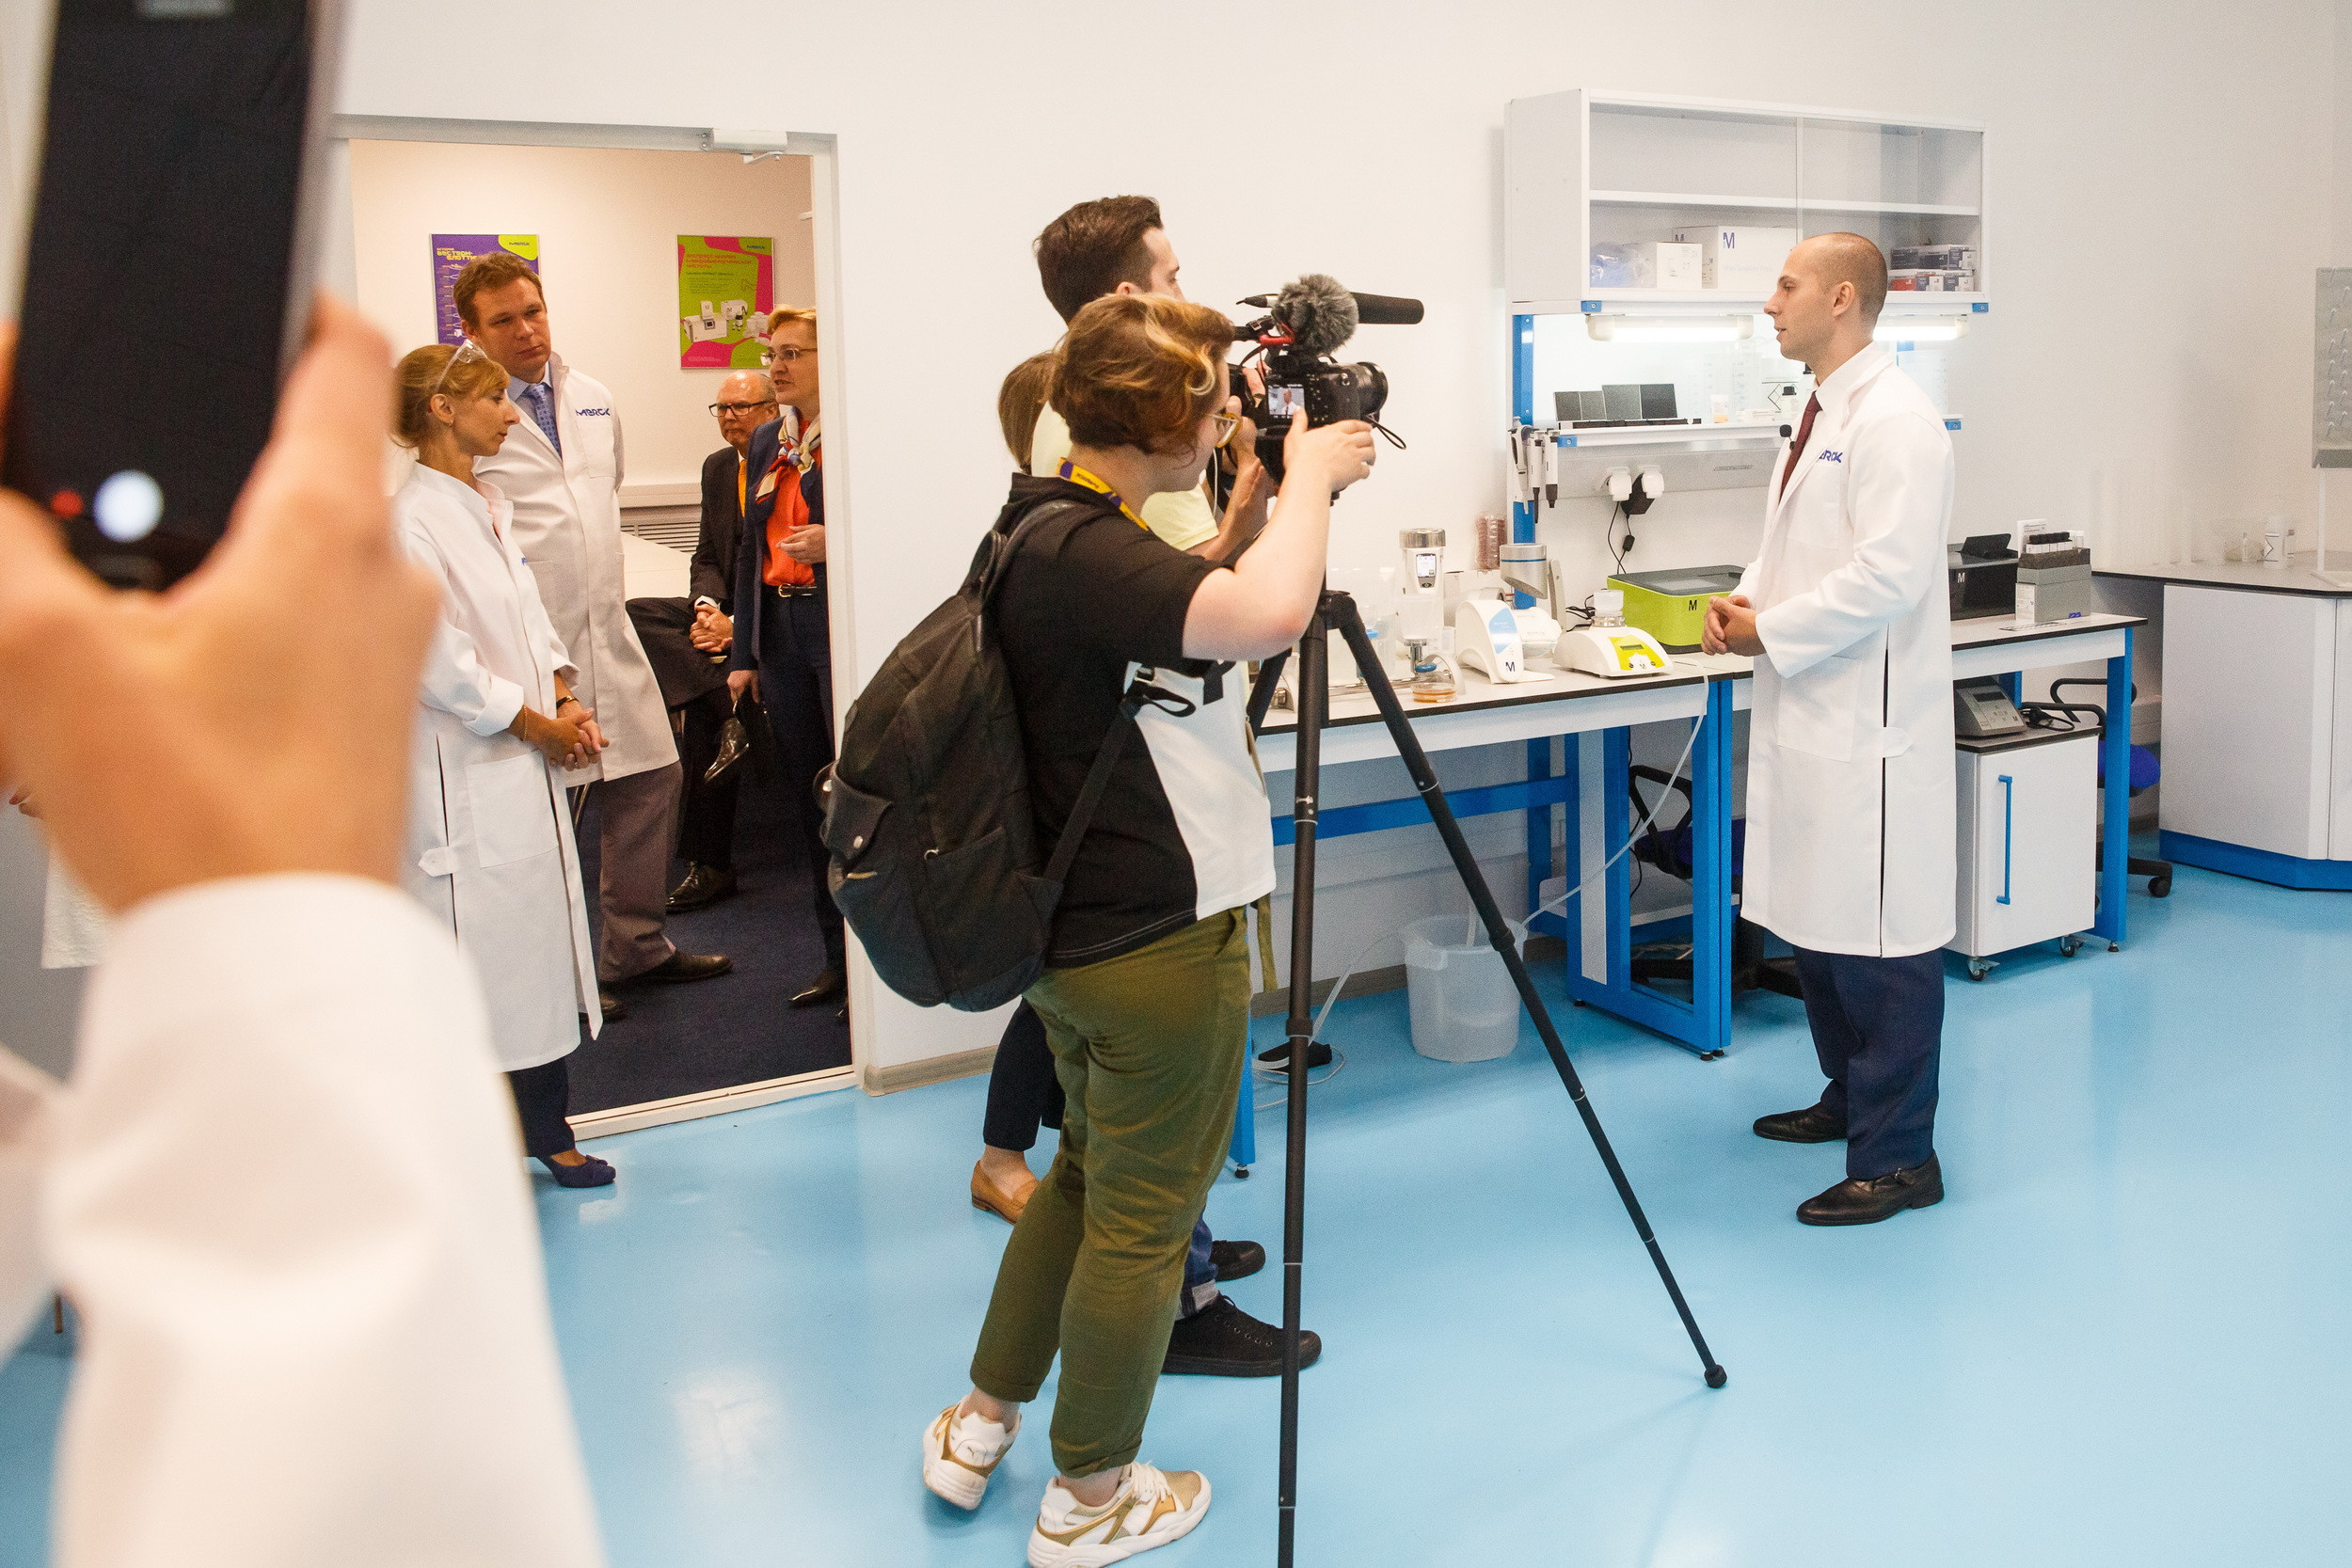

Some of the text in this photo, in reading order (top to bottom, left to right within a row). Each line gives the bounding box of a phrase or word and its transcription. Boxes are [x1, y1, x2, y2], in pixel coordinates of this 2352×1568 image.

[1723, 232, 1735, 249] M
[1957, 572, 1965, 583] M
[1689, 599, 1698, 611] M
[1505, 661, 1516, 673] M
